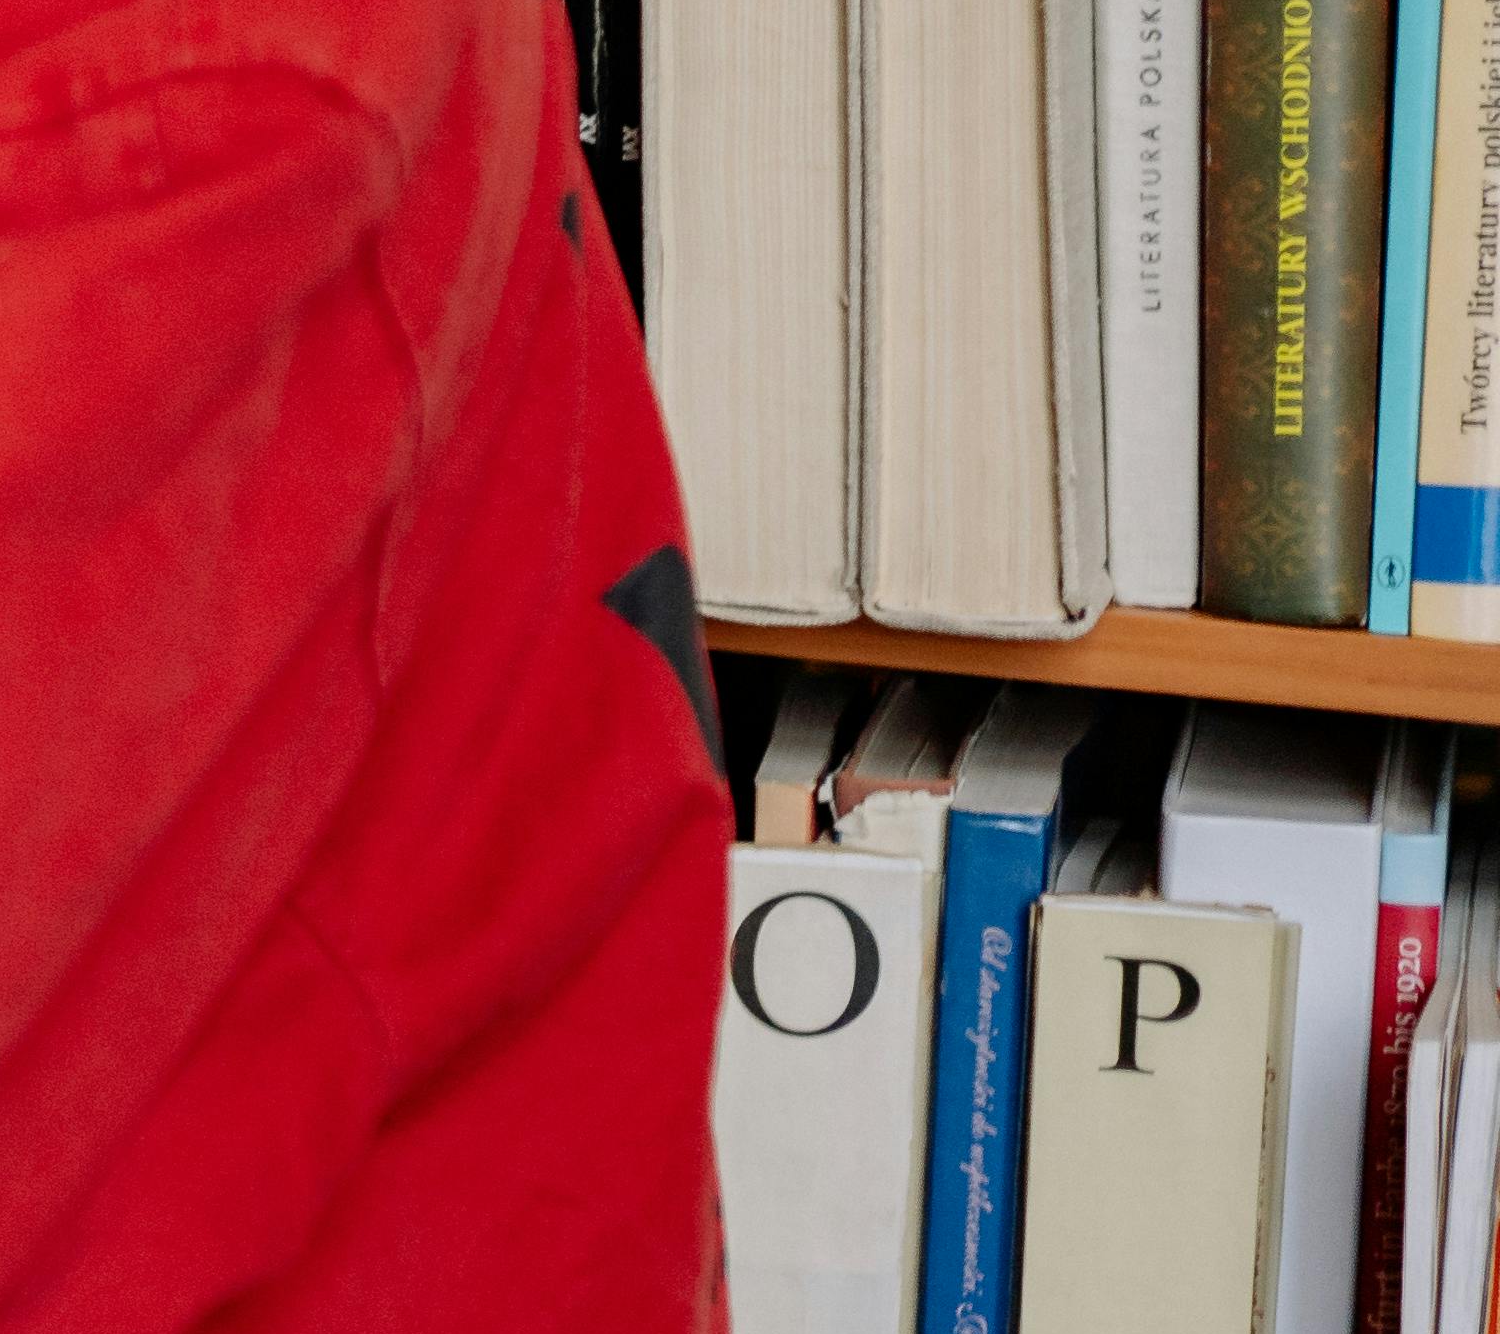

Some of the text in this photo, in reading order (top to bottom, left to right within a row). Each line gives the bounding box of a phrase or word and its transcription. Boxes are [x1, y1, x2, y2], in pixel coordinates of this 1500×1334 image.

[579, 111, 599, 145] XV
[1140, 123, 1163, 314] LITERATURA
[1466, 179, 1500, 319] literatury
[1272, 221, 1308, 437] LITERATURY
[1459, 328, 1498, 436] Twórcy
[730, 890, 881, 1037] O
[1098, 955, 1202, 1075] P
[1395, 936, 1426, 1004] 1920
[1382, 1011, 1416, 1055] bis
